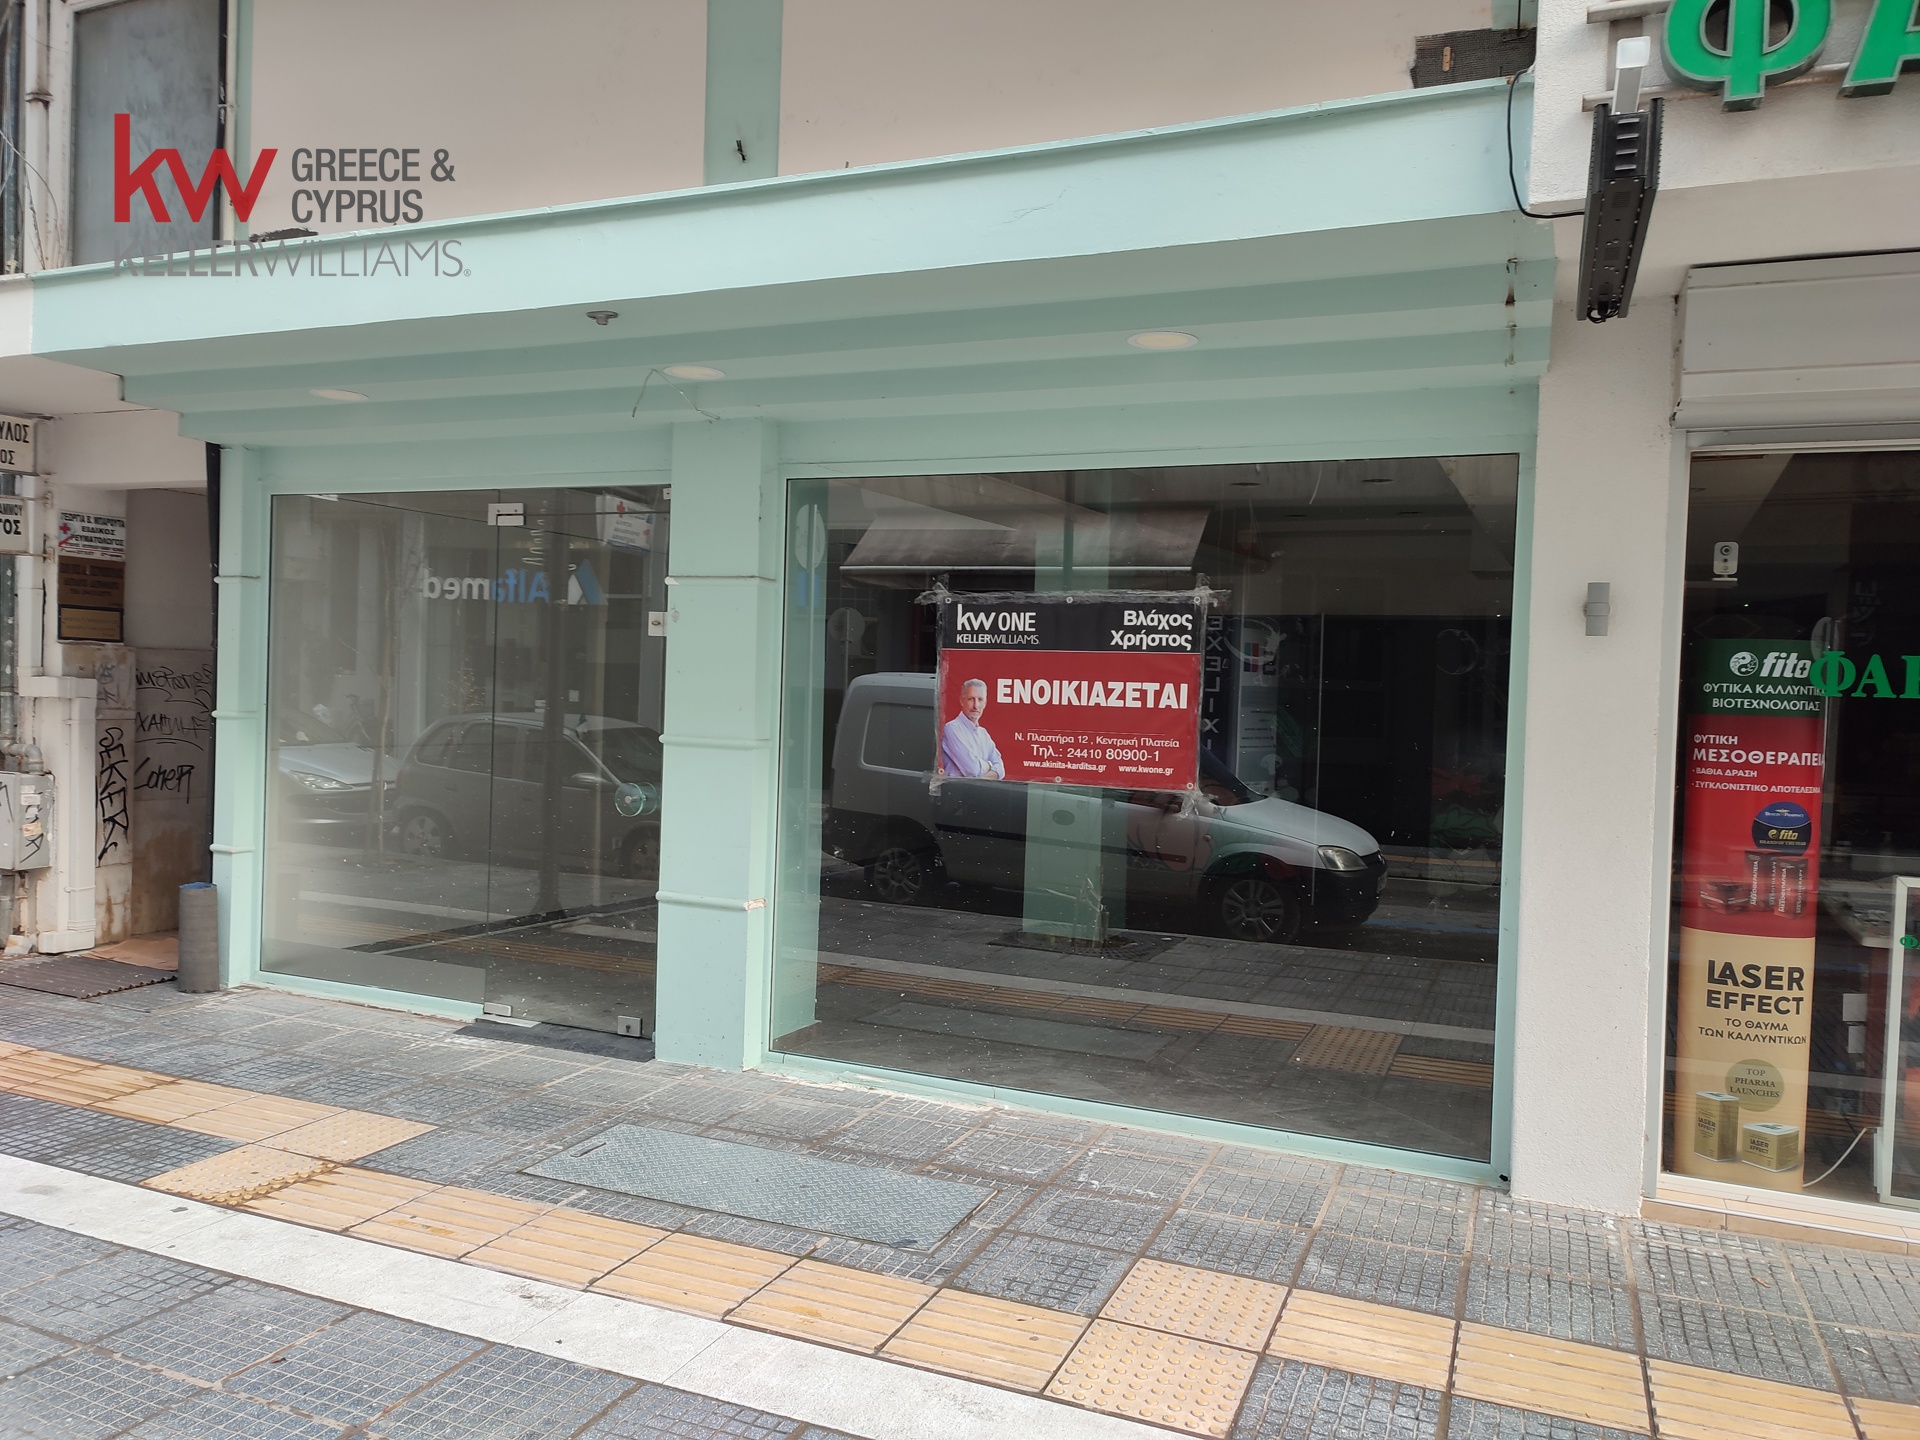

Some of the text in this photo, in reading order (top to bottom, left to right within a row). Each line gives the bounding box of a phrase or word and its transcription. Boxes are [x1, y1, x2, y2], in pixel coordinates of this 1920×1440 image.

[998, 612, 1036, 632] ONE
[1123, 610, 1193, 631] Βλάχος
[1110, 629, 1193, 650] Χρήστος
[996, 678, 1188, 710] ΕΝΟΙΚΙΑΖΕΤΑΙ
[1703, 682, 1752, 694] ΦΥΤΙΚΑ
[1712, 698, 1820, 711] ΒΙΟΤΕΧΝΟΛΟΓΙΑΣ
[1027, 732, 1074, 744] Πλαστήρα
[1096, 736, 1138, 748] Κεντρική
[1140, 738, 1180, 748] Πλατεία
[1694, 734, 1738, 745] ΦΥΤΙΚΗ
[1066, 748, 1102, 759] 24410
[1106, 748, 1160, 762] 80900-1
[1023, 759, 1174, 776] www.akinita-karditsa.gr www.kwone.gr
[1724, 769, 1758, 778] ΔΡΑΣΗ
[1708, 959, 1805, 992] LASER
[1706, 989, 1804, 1016] EFFECT
[1725, 1018, 1788, 1032] ΤΟ ΘΑΥΜΑ
[1698, 1026, 1807, 1045] ΤΩΝ ΚΑΛΛΥΝΤΙΚΩΝ
[1747, 1068, 1766, 1076] TOP
[1734, 1077, 1776, 1088] PHARMA
[1730, 1086, 1780, 1098] LAUNCHES
